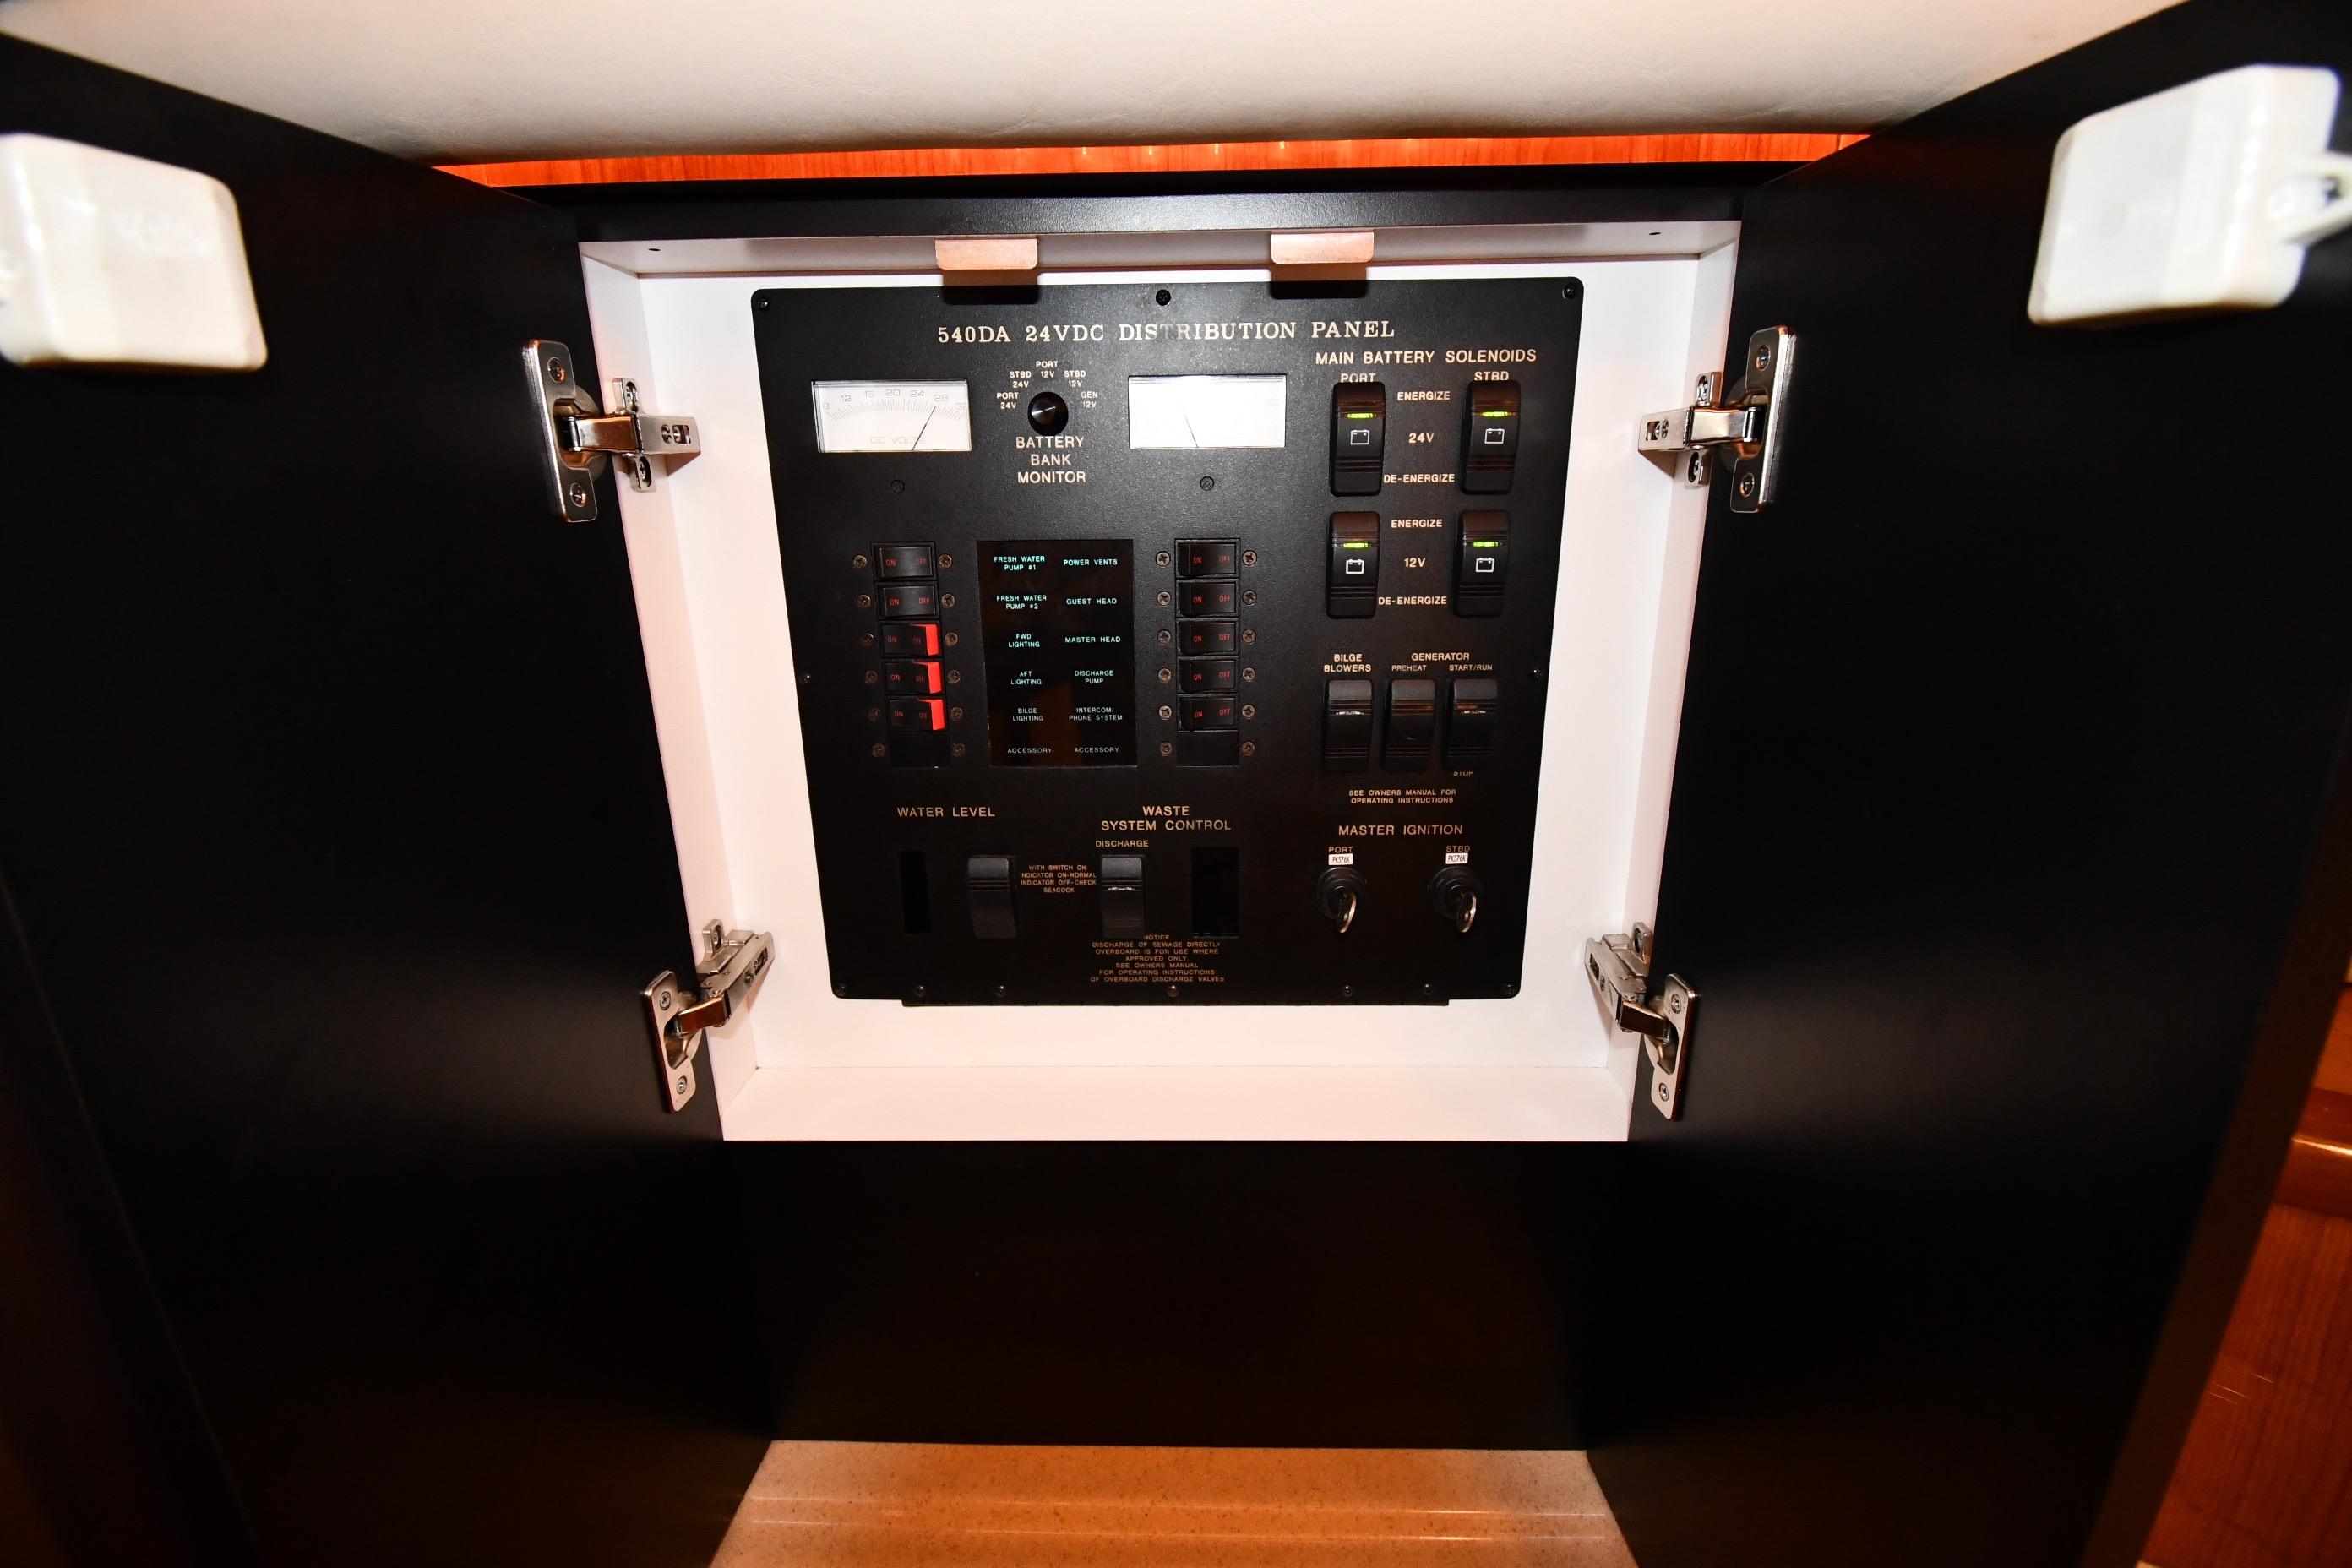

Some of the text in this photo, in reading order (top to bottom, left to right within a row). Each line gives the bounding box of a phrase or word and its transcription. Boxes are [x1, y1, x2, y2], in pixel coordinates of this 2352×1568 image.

[938, 320, 1395, 343] 540DA 24VDC DISTRIBUTION PANEL
[1315, 349, 1537, 365] MAIN BATTERY SOLENOIDS
[1340, 373, 1376, 383] PORT
[1473, 371, 1510, 381] STBD
[1396, 391, 1451, 400] ENERGIZE
[1016, 436, 1084, 449] BATTERY
[1408, 432, 1435, 443] 24V
[1030, 454, 1072, 466] BANK
[1017, 471, 1086, 483] MONITOR
[1383, 472, 1455, 483] DE-ENERGIZE
[1391, 519, 1443, 528] ENERGIZE
[1404, 558, 1426, 568] 12V
[1378, 596, 1447, 606] DE-ENERGIZE
[1333, 653, 1363, 662] BILGE
[1411, 652, 1470, 661] GENERATOR
[1324, 664, 1372, 672] BLOWERS
[896, 806, 996, 817] WATER LEVEL
[1142, 805, 1190, 816] WASTE
[1101, 819, 1232, 831] SYSTEM CONTROL
[1338, 824, 1463, 836] MASTER IGNITION
